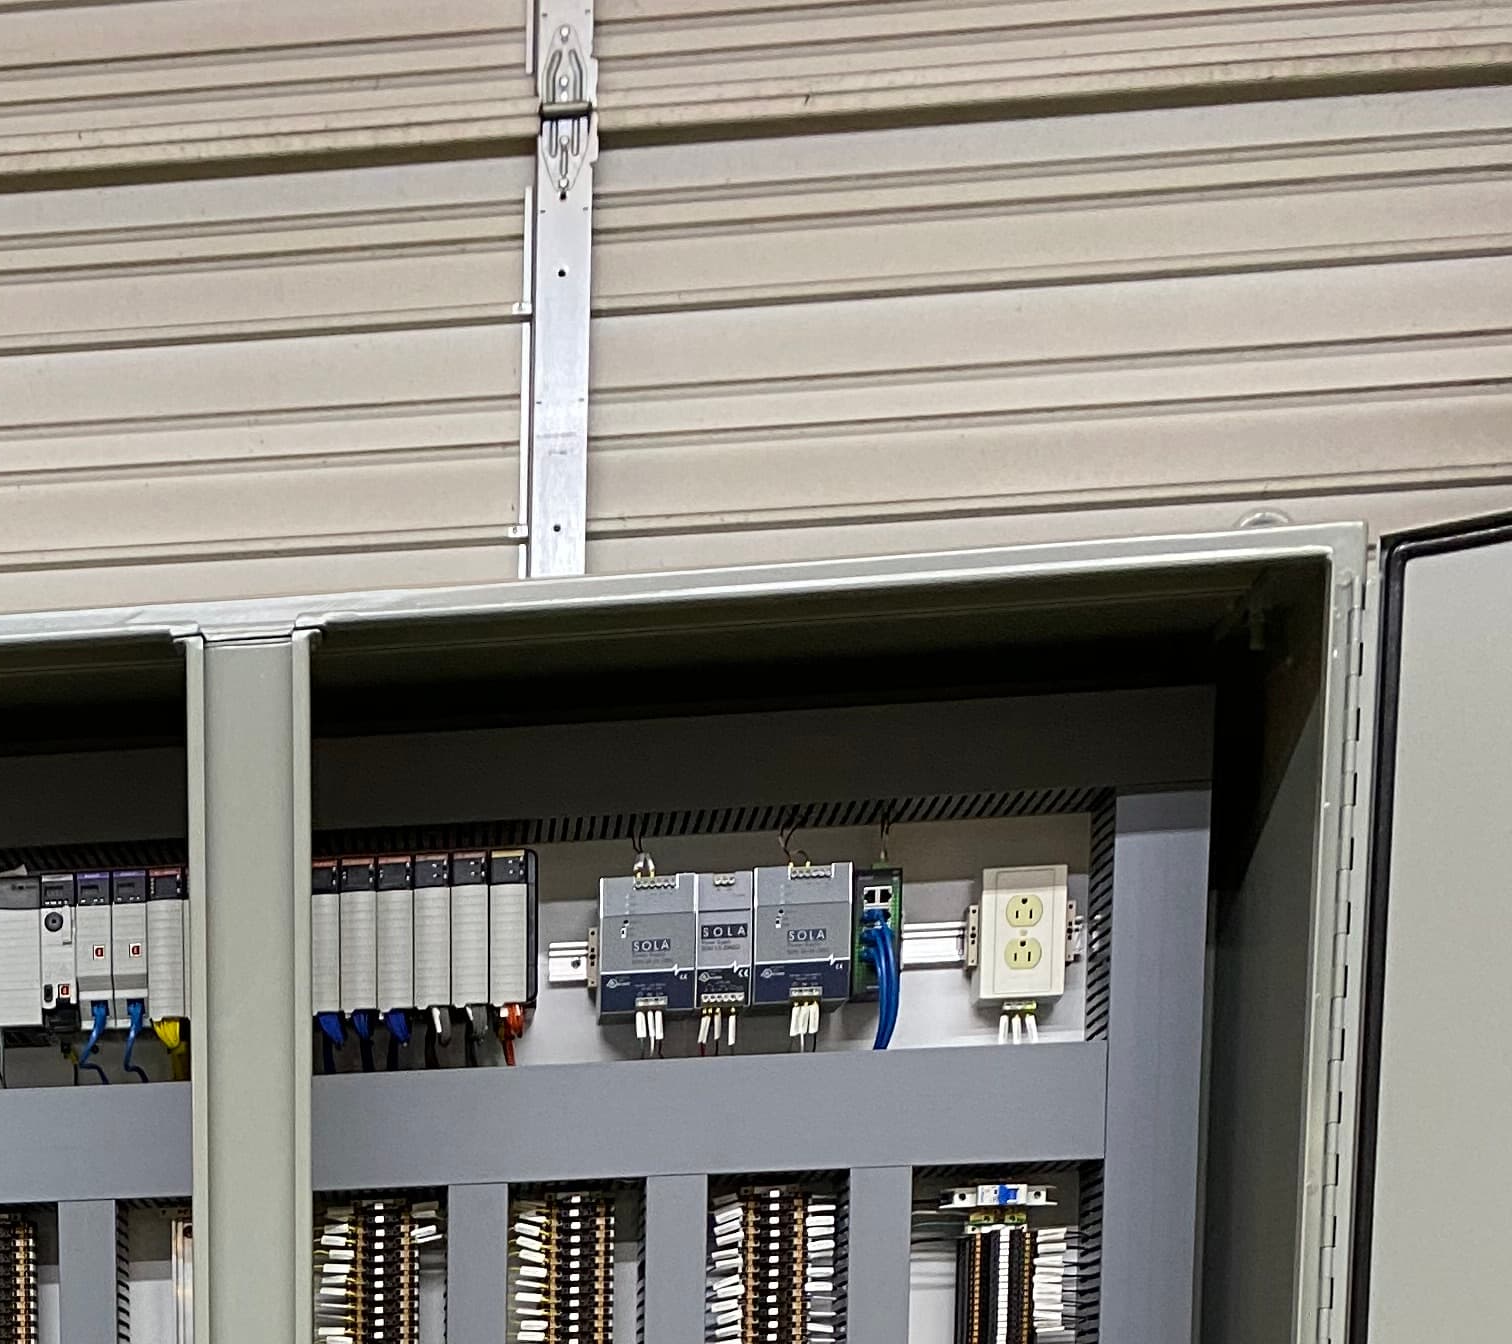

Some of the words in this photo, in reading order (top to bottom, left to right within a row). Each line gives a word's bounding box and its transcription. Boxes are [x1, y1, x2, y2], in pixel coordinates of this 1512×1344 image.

[703, 926, 746, 938] SOLA
[789, 929, 825, 941] SOLA
[633, 939, 670, 952] SOLA
